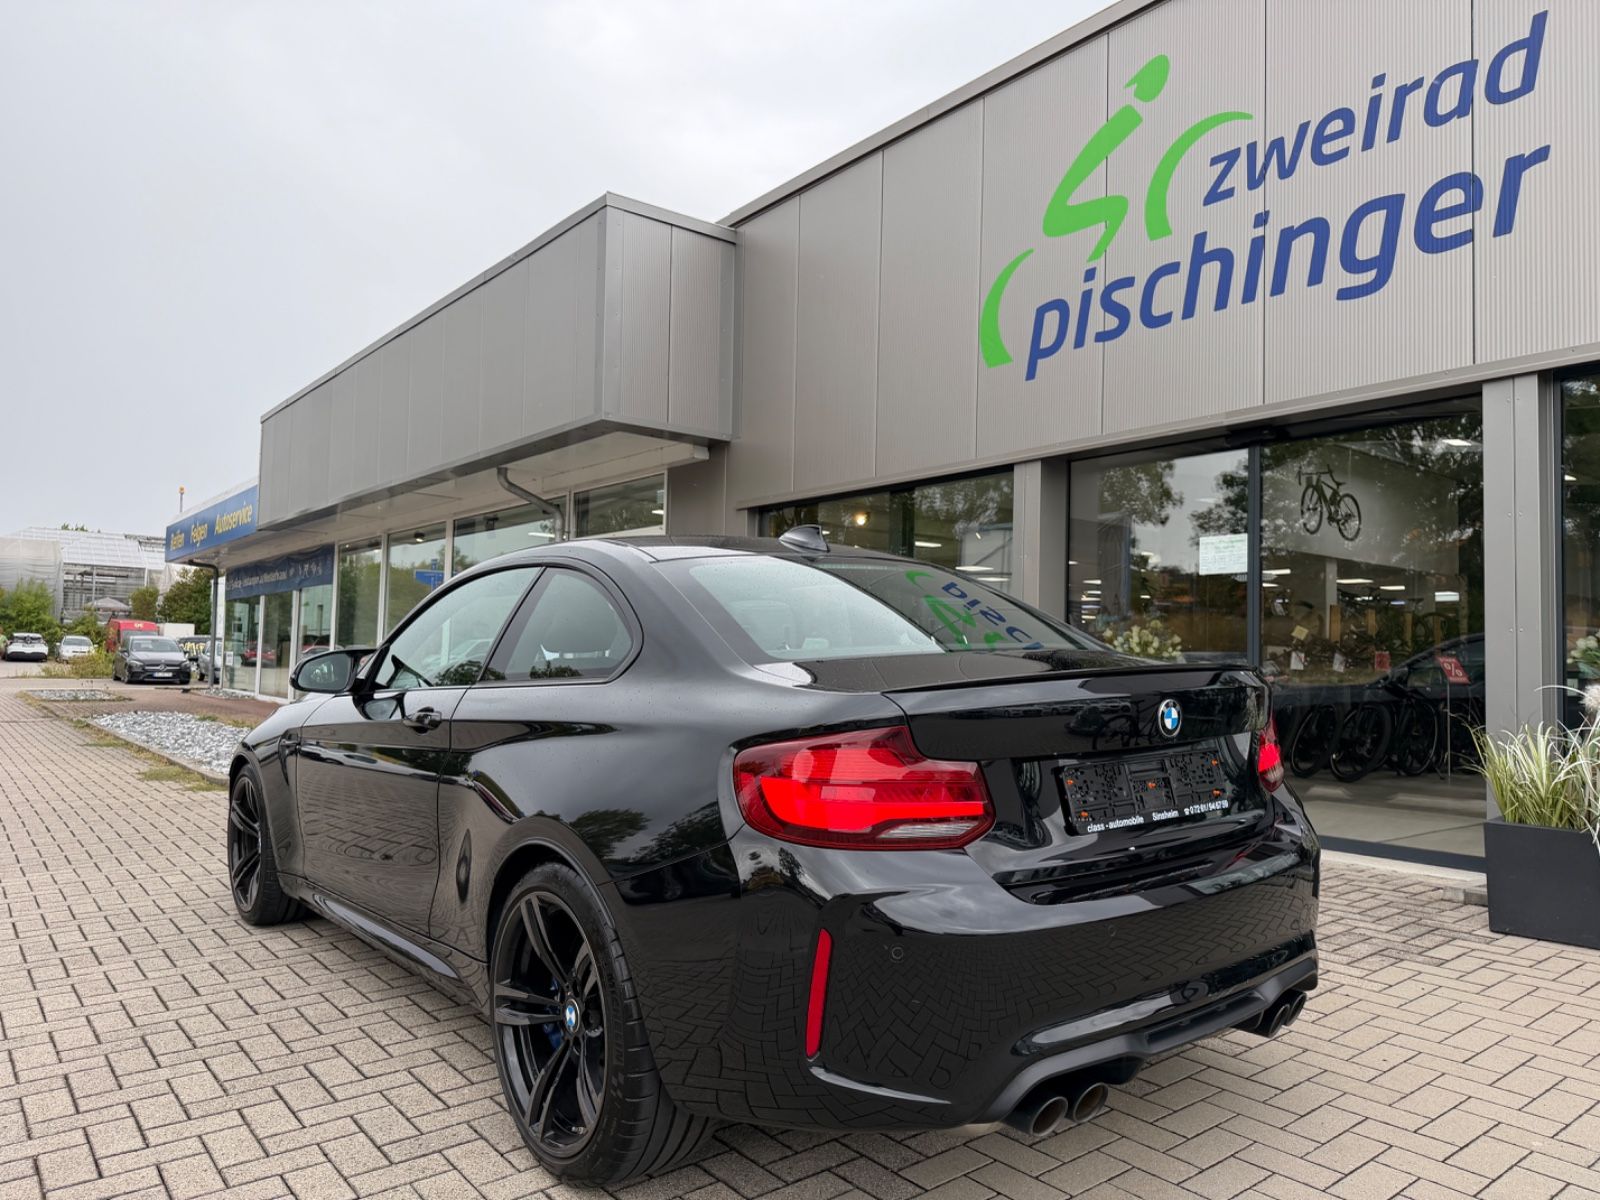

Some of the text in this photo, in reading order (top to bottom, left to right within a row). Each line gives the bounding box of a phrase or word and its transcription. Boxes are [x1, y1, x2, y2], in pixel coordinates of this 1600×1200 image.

[1202, 9, 1549, 207] zweirad
[1025, 144, 1552, 382] pischinger
[214, 501, 253, 536] Autoservice
[1087, 822, 1105, 833] class
[1109, 815, 1145, 829] automobile
[1152, 809, 1179, 821] Sinsheim
